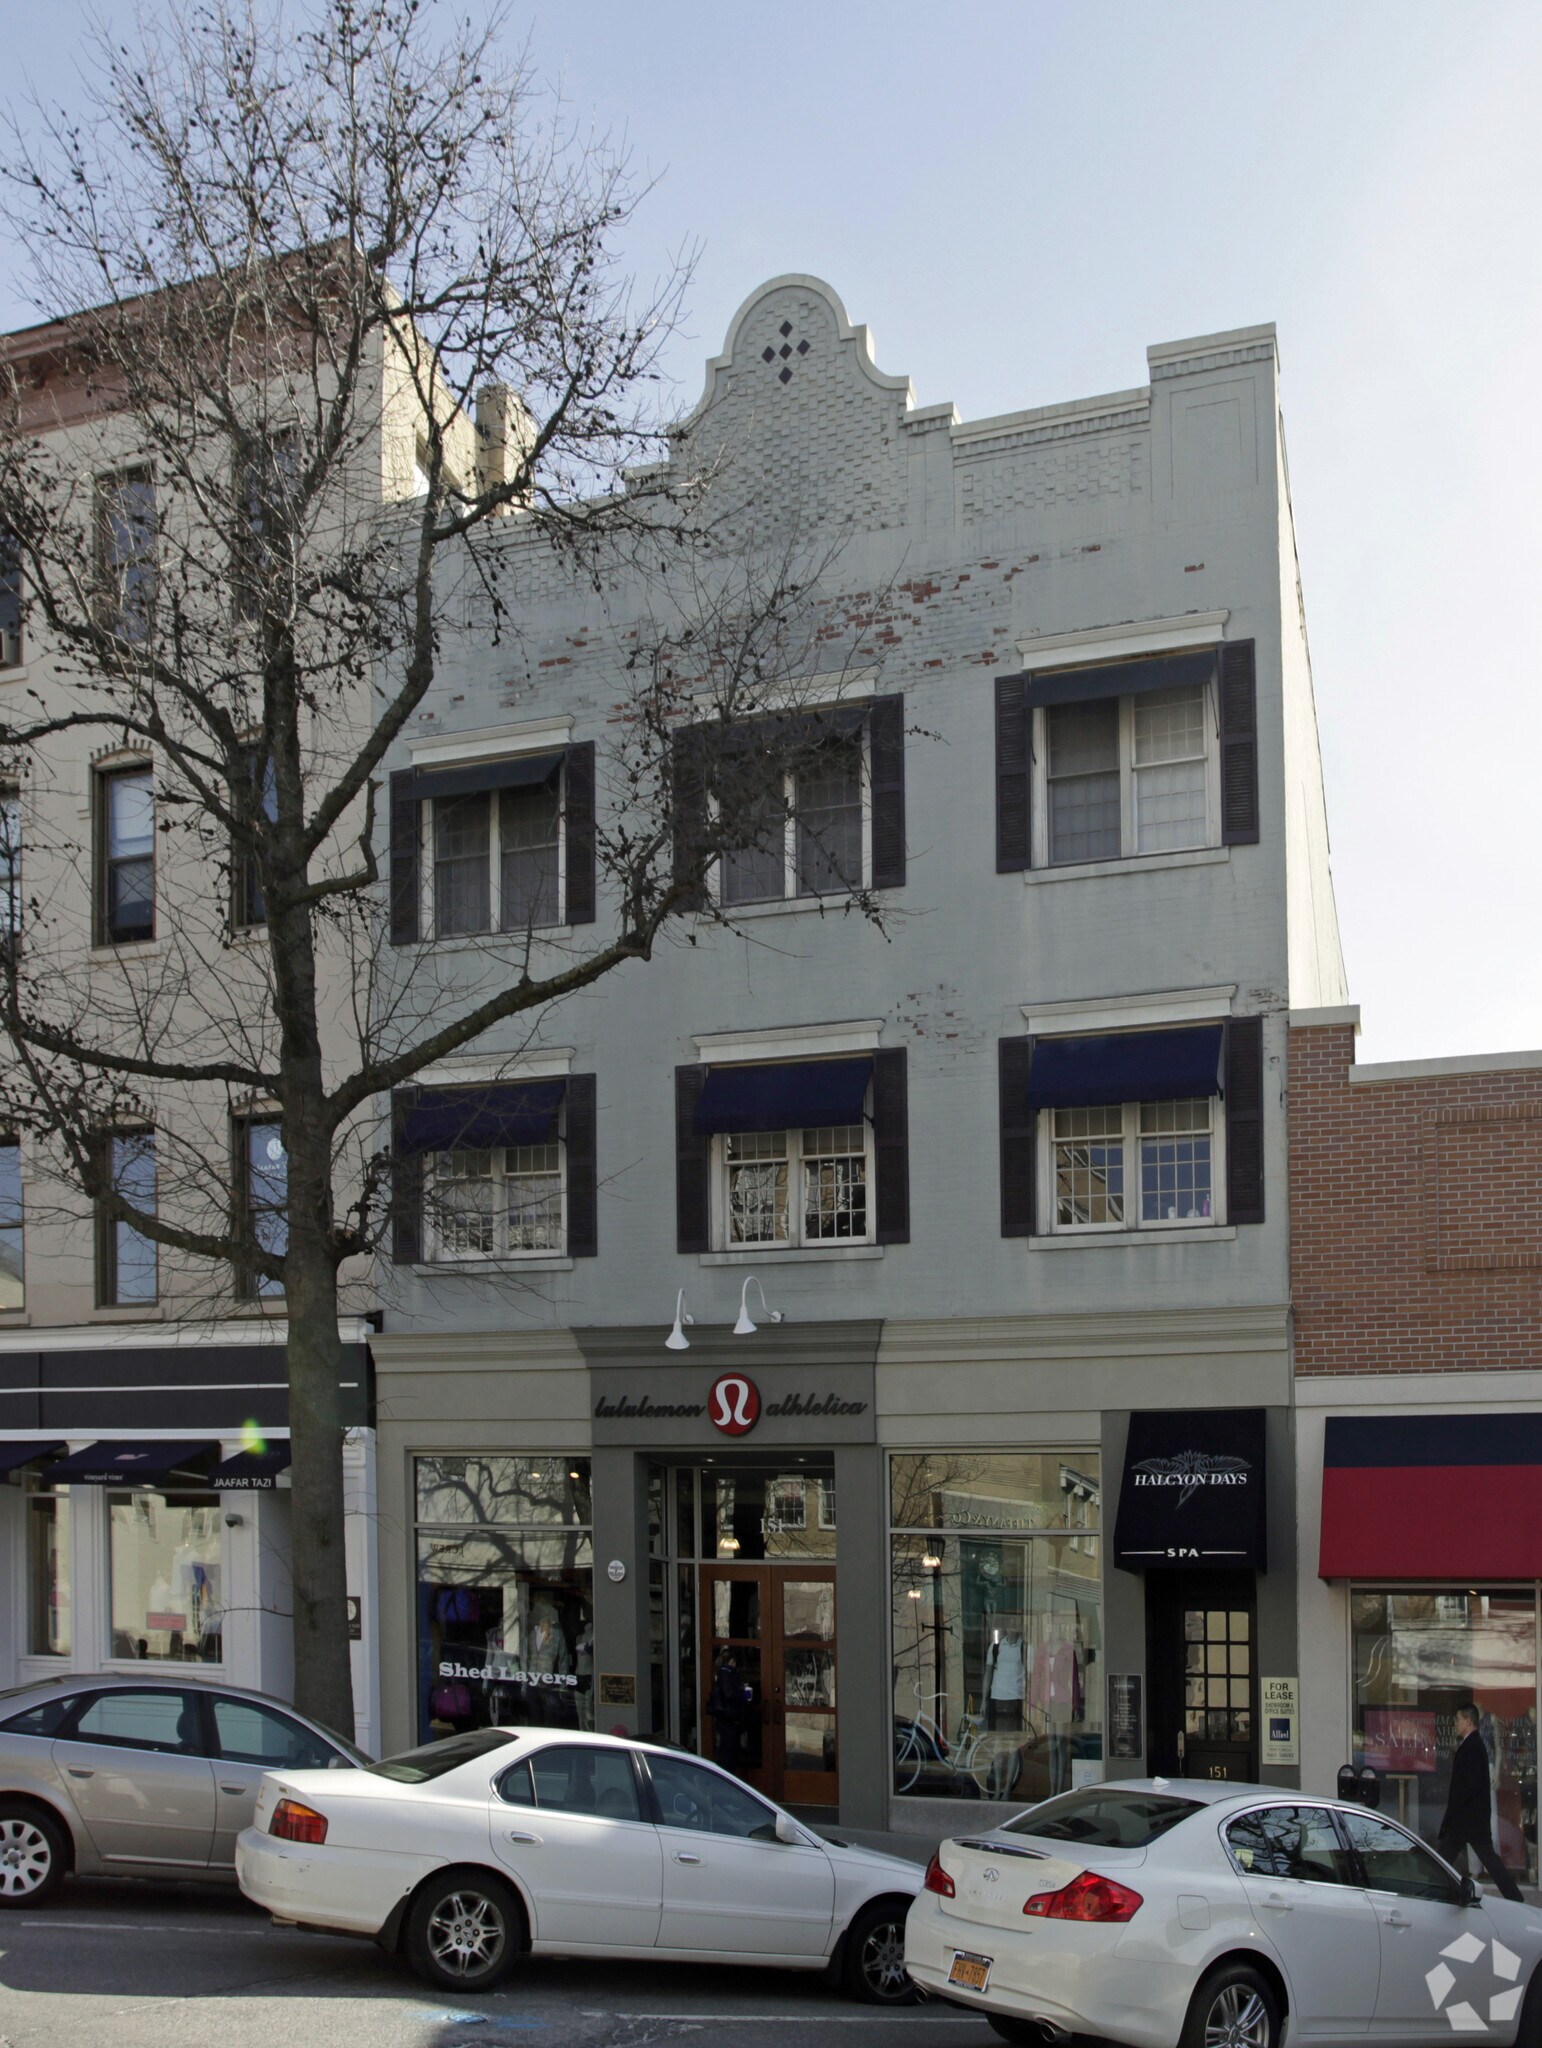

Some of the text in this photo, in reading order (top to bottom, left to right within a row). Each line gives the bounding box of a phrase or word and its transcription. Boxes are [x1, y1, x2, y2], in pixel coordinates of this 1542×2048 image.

[593, 1393, 868, 1418] lululemon athletica
[213, 1478, 272, 1488] JAAFAR TAZI
[1134, 1472, 1247, 1486] HALCYON DAYS
[1167, 1548, 1199, 1558] SPA
[438, 1661, 578, 1687] Shed Layers
[1269, 1682, 1289, 1691] FOR
[1264, 1691, 1294, 1700] LEASE
[1271, 1730, 1289, 1739] Allied
[1209, 1766, 1227, 1779] 151
